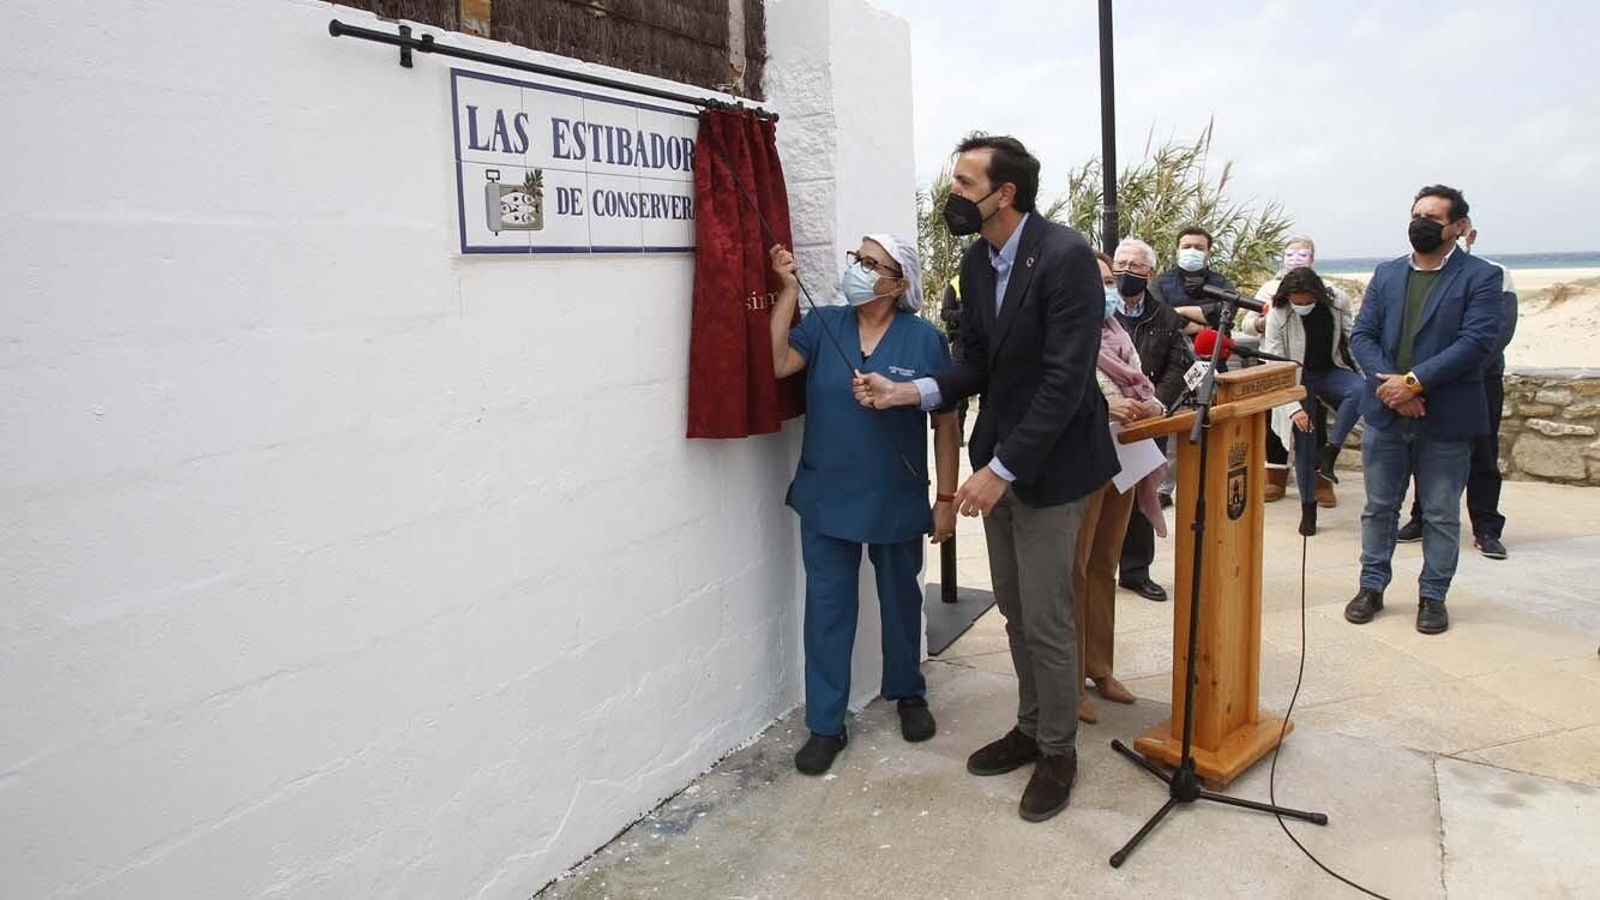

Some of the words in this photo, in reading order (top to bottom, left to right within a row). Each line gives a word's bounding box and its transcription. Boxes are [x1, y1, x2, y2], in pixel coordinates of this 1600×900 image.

[465, 105, 530, 155] LAS
[551, 116, 696, 173] ESTIBADOR
[556, 186, 583, 216] DE
[592, 189, 697, 221] CONSERVER
